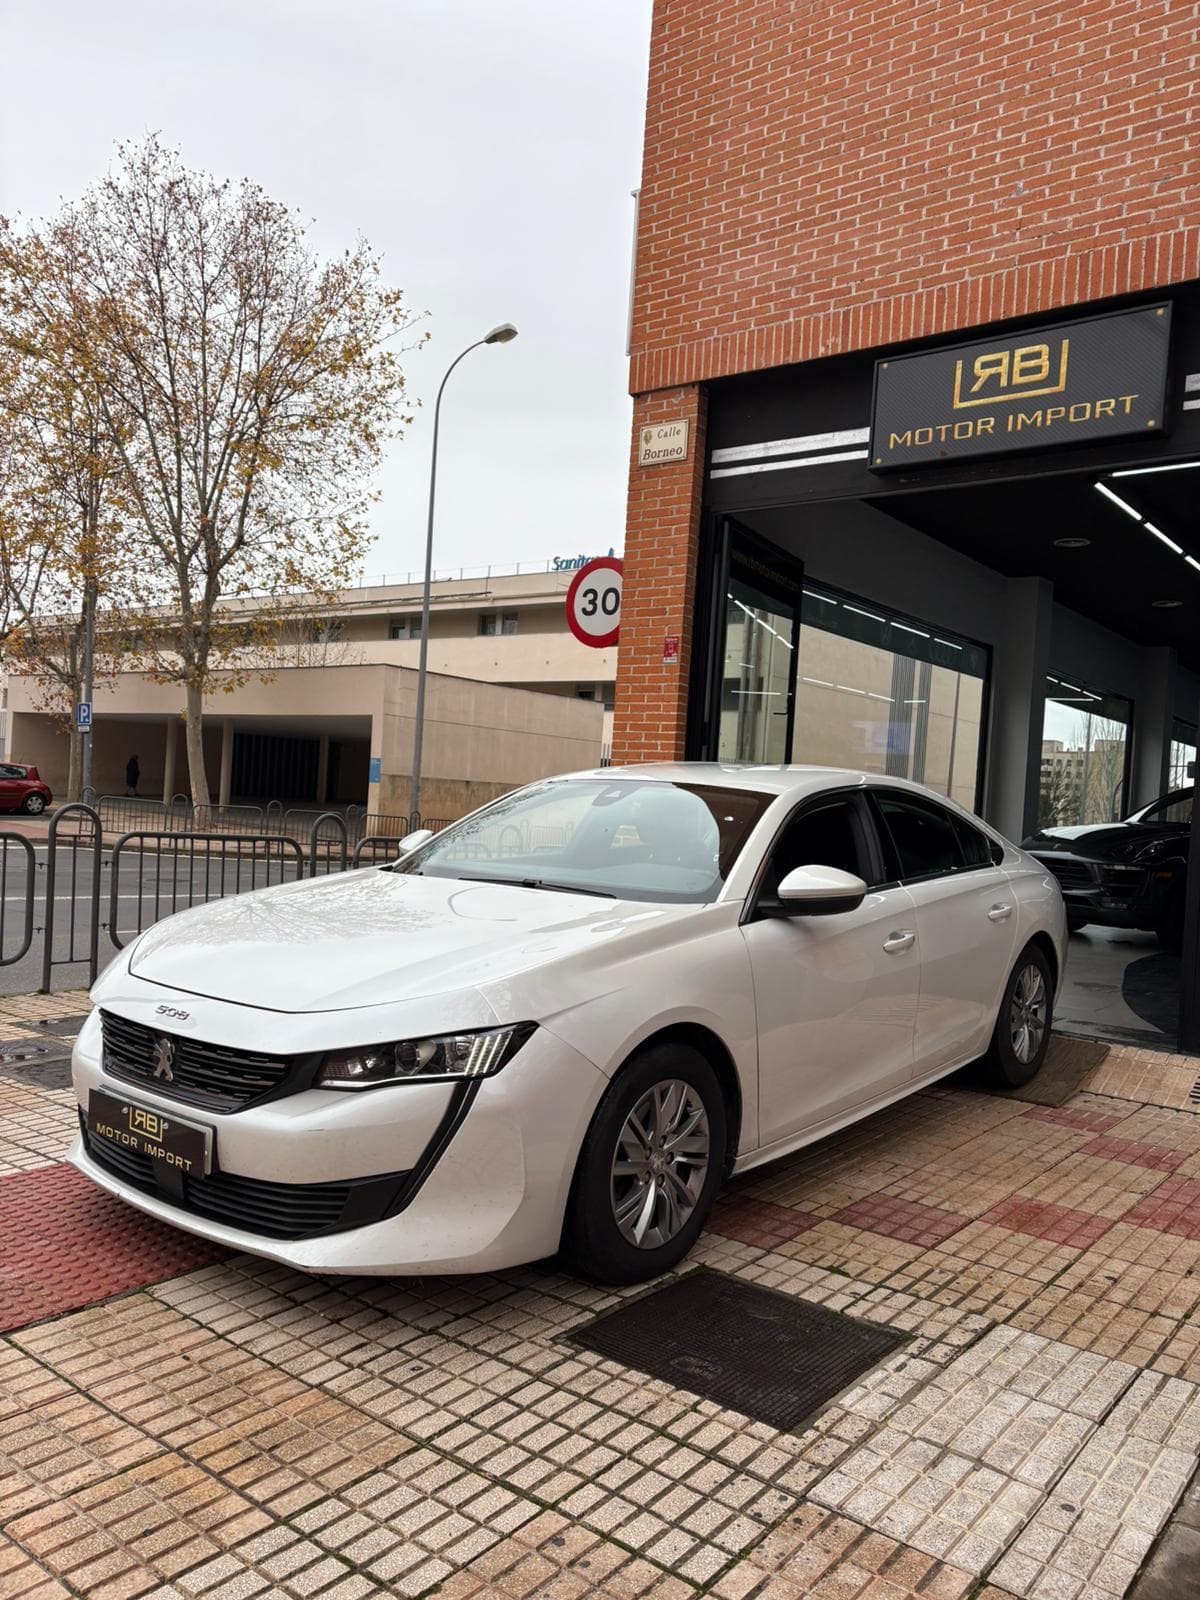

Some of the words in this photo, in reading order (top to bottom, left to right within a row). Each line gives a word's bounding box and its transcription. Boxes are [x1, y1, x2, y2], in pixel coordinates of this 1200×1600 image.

[888, 416, 995, 449] MOTOR
[1006, 394, 1139, 433] IMPORT
[657, 425, 682, 440] Calle
[643, 446, 683, 461] Borneo
[581, 587, 620, 617] 30
[80, 705, 89, 722] P
[155, 1004, 190, 1021] 508
[96, 1122, 138, 1148] MOTOR
[144, 1142, 192, 1171] IMPORT
